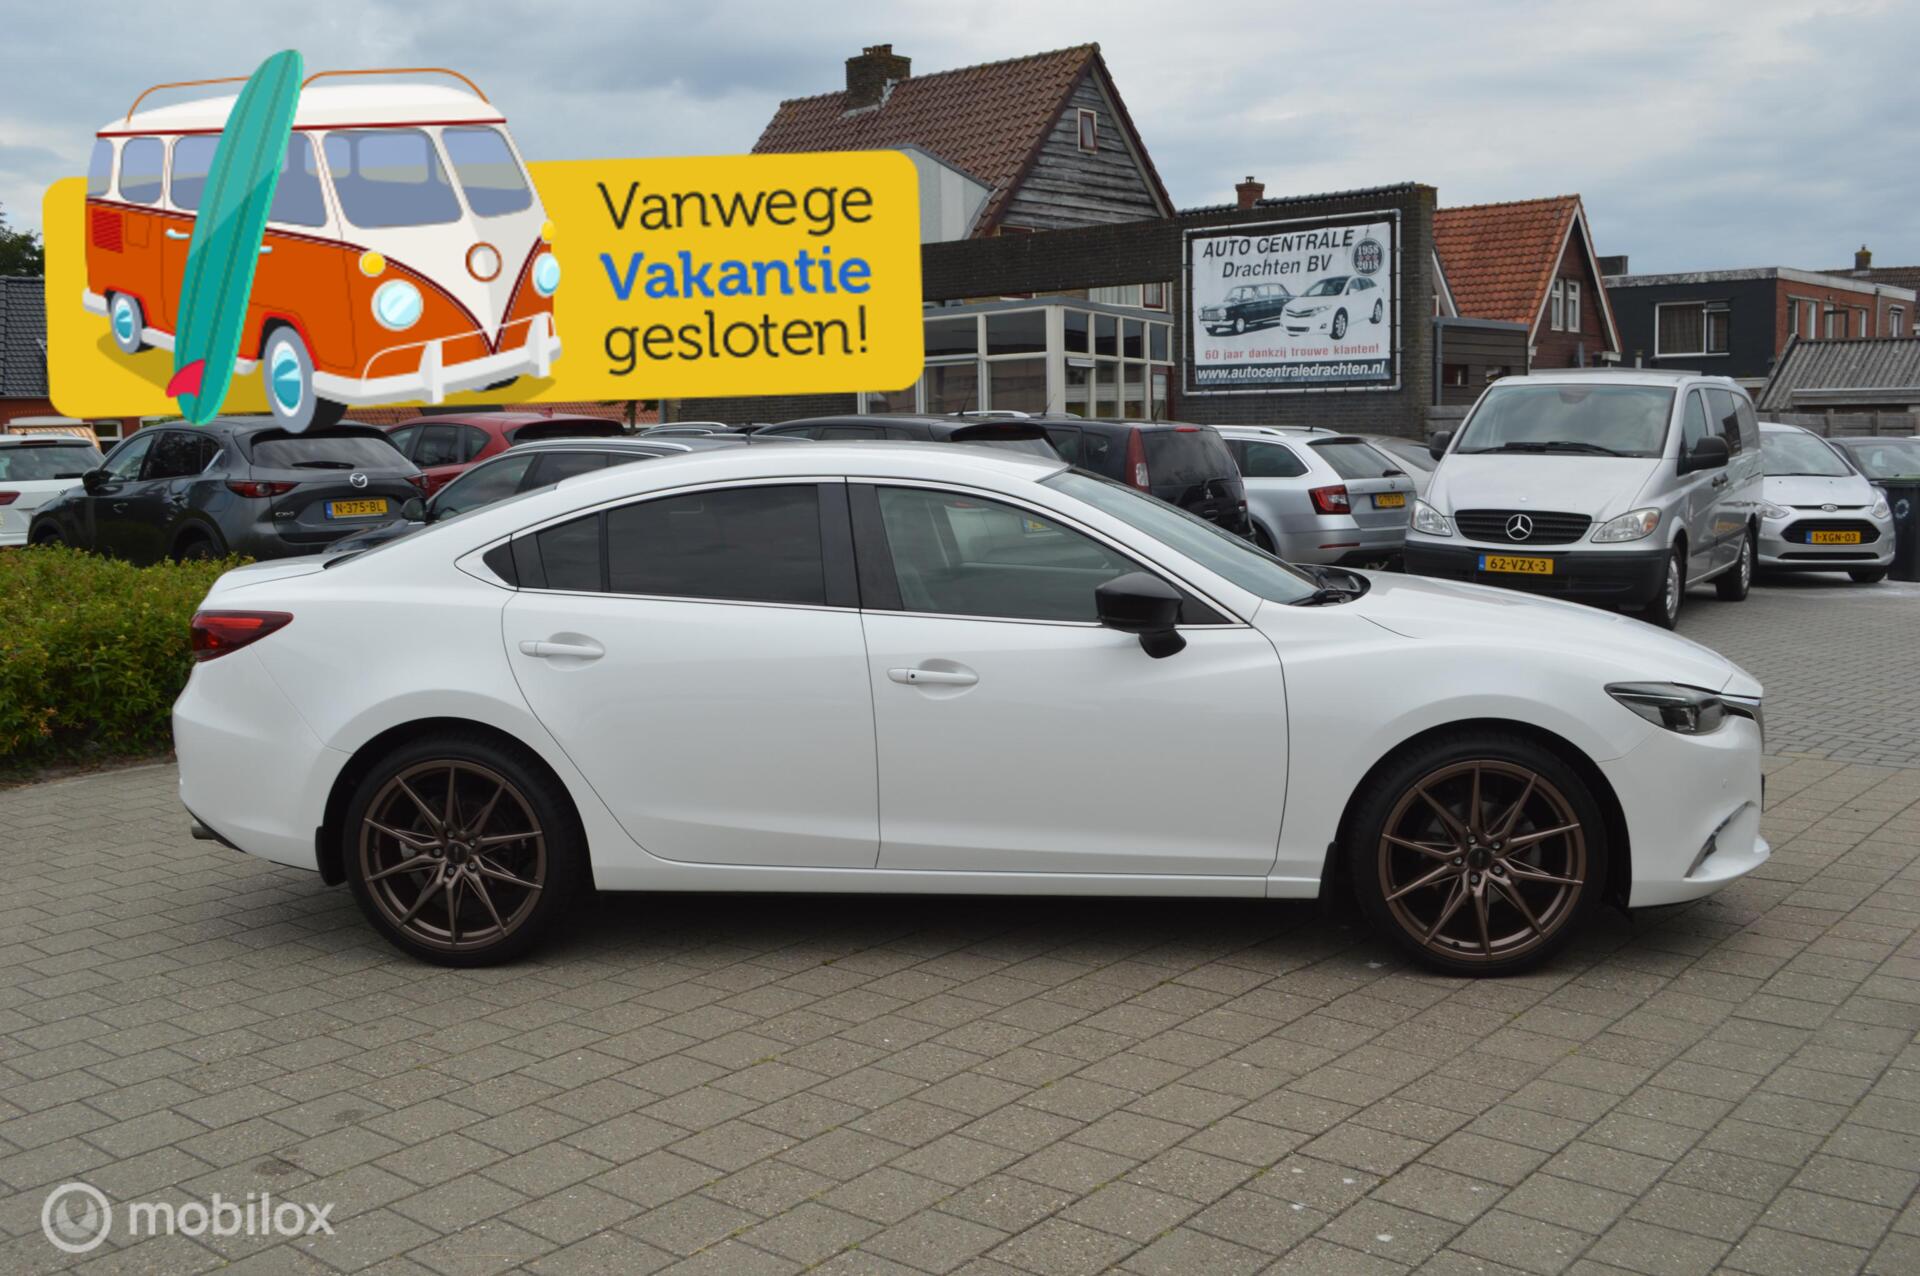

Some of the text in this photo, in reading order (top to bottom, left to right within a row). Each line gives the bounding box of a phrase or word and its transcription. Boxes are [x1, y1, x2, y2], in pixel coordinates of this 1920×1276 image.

[1203, 230, 1354, 258] AUTO CENTRALE
[1222, 254, 1332, 278] Drachten BV
[1205, 343, 1379, 360] 60 jaar dankzij trouwe klanten!
[1198, 361, 1385, 380] www.autocentraledrachten.nl
[335, 501, 383, 513] N-375-BL
[1490, 558, 1546, 572] 62-VZX-3
